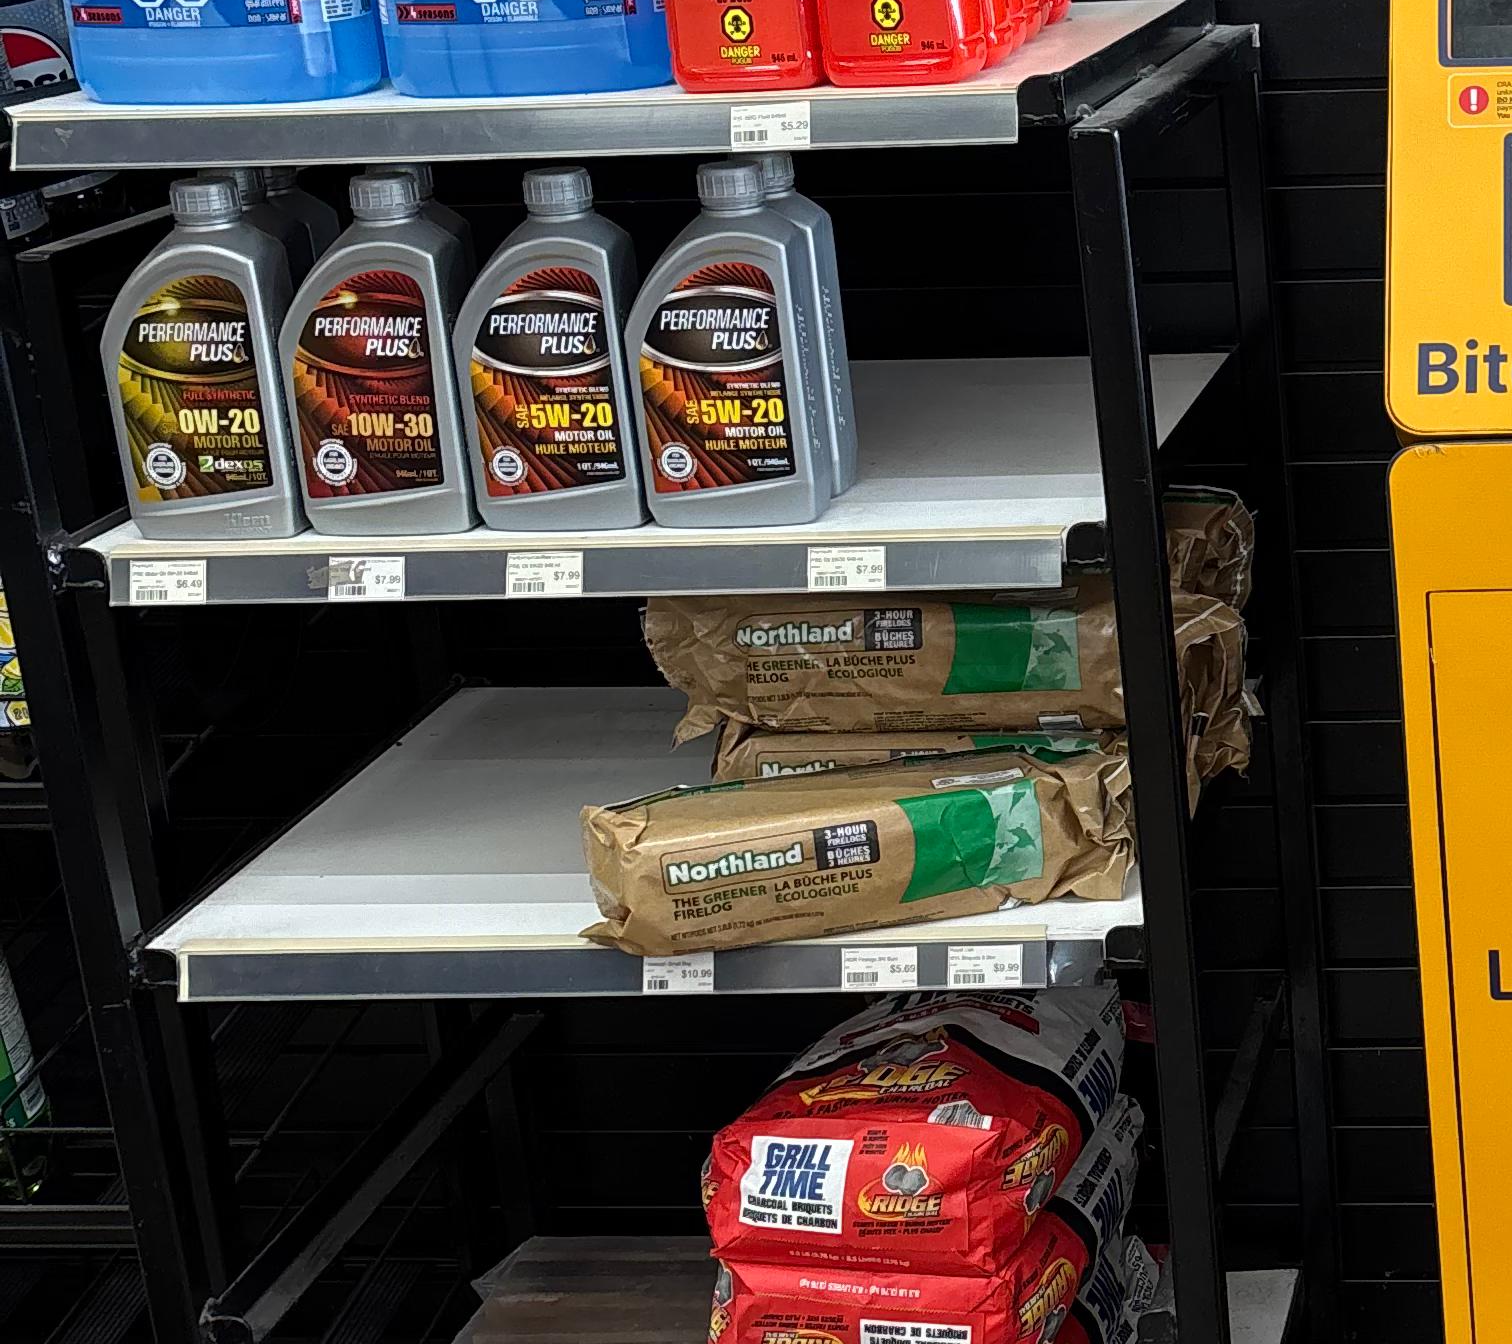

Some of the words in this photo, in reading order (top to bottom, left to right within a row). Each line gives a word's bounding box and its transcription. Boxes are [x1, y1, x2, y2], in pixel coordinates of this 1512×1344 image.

[146, 8, 200, 21] DANGER
[481, 3, 538, 16] DANGER
[871, 34, 910, 45] DANGER
[721, 46, 760, 57] DANGER
[781, 121, 808, 130] $5.29
[315, 317, 422, 338] PERFORMANCE
[490, 312, 598, 336] PERFORMANCE
[661, 307, 770, 330] PERFORMANCE
[139, 322, 245, 343] PERFORMANCE
[712, 331, 756, 350] PLUS
[190, 344, 233, 362] PLUS
[366, 339, 408, 357] PLUS
[541, 336, 584, 355] PLUS
[207, 390, 255, 400] SYNTHETIC
[350, 395, 398, 405] SYNTHETIC
[401, 396, 430, 405] BLEND
[530, 402, 613, 428] 5W-20
[701, 398, 784, 424] 5W-20
[179, 408, 260, 434] 0W-20
[332, 424, 348, 435] SAE
[347, 413, 433, 437] 10W-30
[555, 431, 595, 442] MOTOR
[597, 430, 615, 440] OIL
[725, 427, 766, 437] MOTOR
[768, 426, 786, 436] OIL
[194, 436, 241, 448] MOTOR
[243, 435, 264, 448] OIL
[367, 439, 412, 452] MOTOR
[415, 439, 435, 451] OIL
[535, 444, 567, 455] HUILE
[569, 442, 617, 453] MOTEUR
[705, 440, 736, 450] HUILE
[740, 438, 787, 449] MOTEUR
[875, 611, 913, 620] 3-HOUR
[737, 620, 853, 646] Northland
[826, 657, 839, 668] LA
[844, 655, 882, 666] BÛCHE
[887, 655, 915, 665] PLUS
[828, 667, 903, 679] ÉCOLOGIQUE
[824, 823, 867, 839] 3-HOUR
[827, 845, 870, 860] BÛCHES
[669, 843, 803, 885] Northland
[774, 880, 790, 891] LA
[794, 873, 837, 888] BÛCHE
[841, 869, 873, 881] PLUS
[672, 896, 700, 909] THE
[704, 885, 767, 905] GREENER
[775, 883, 859, 903] ÉCOLOGIQUE
[673, 903, 732, 921] FIRELOG
[682, 969, 712, 979] $10.99
[765, 1142, 832, 1171] GRILL
[759, 1170, 826, 1200] TIME
[872, 1194, 943, 1213] RIDGE
